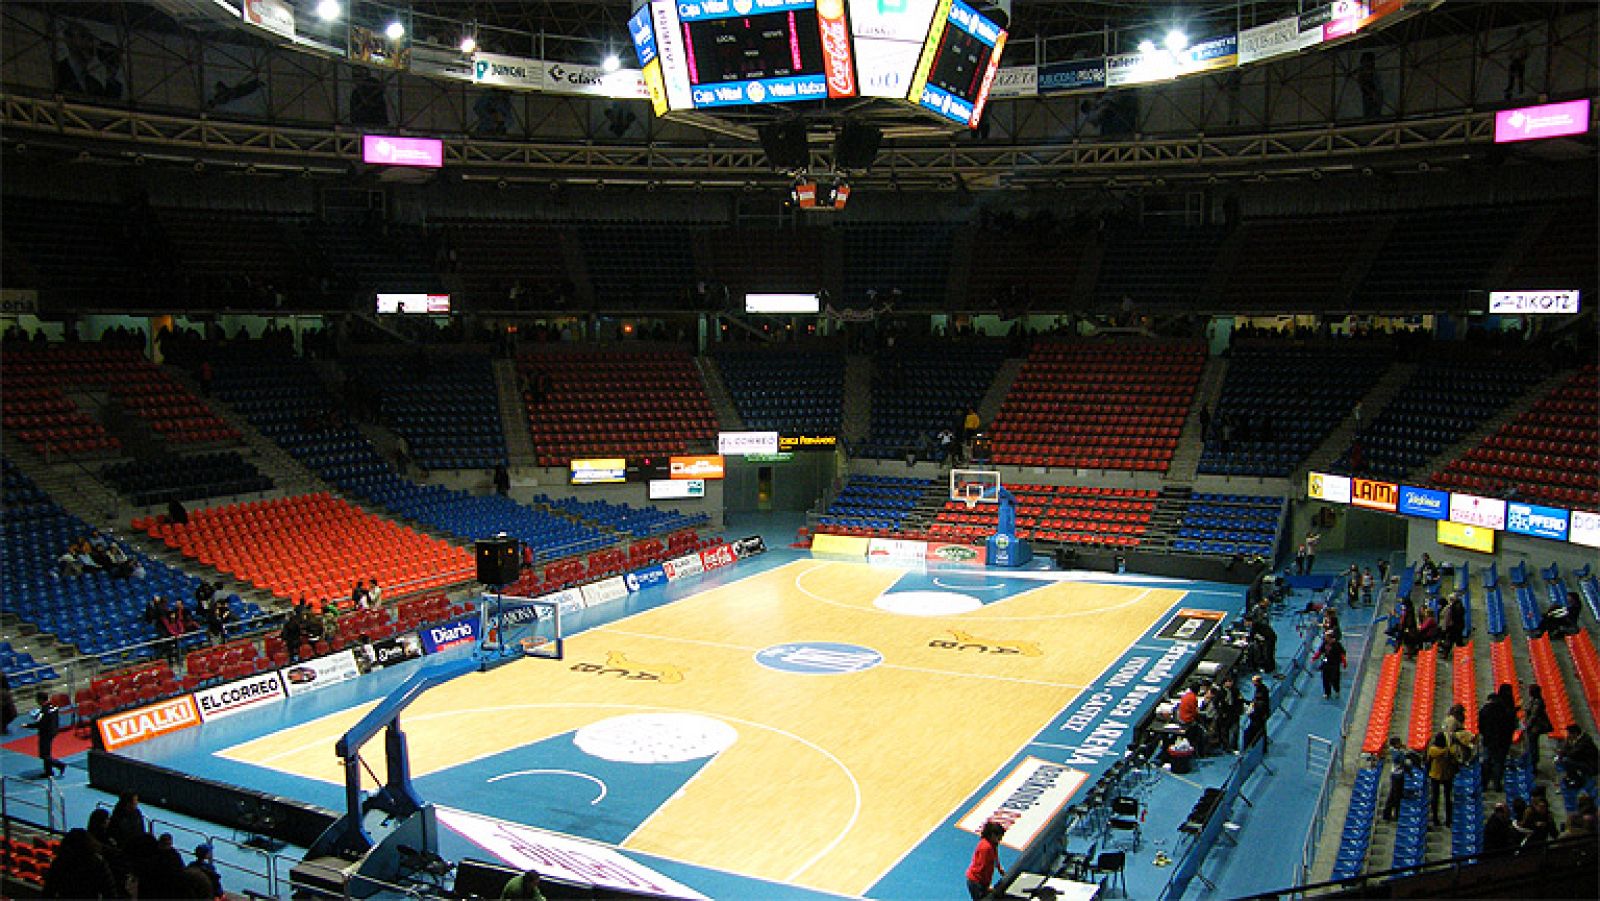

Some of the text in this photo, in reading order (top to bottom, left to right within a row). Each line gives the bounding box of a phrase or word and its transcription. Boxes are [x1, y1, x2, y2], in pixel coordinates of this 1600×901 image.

[430, 622, 472, 643] Diario
[112, 702, 188, 737] VIALKI
[1065, 719, 1129, 764] ARENA
